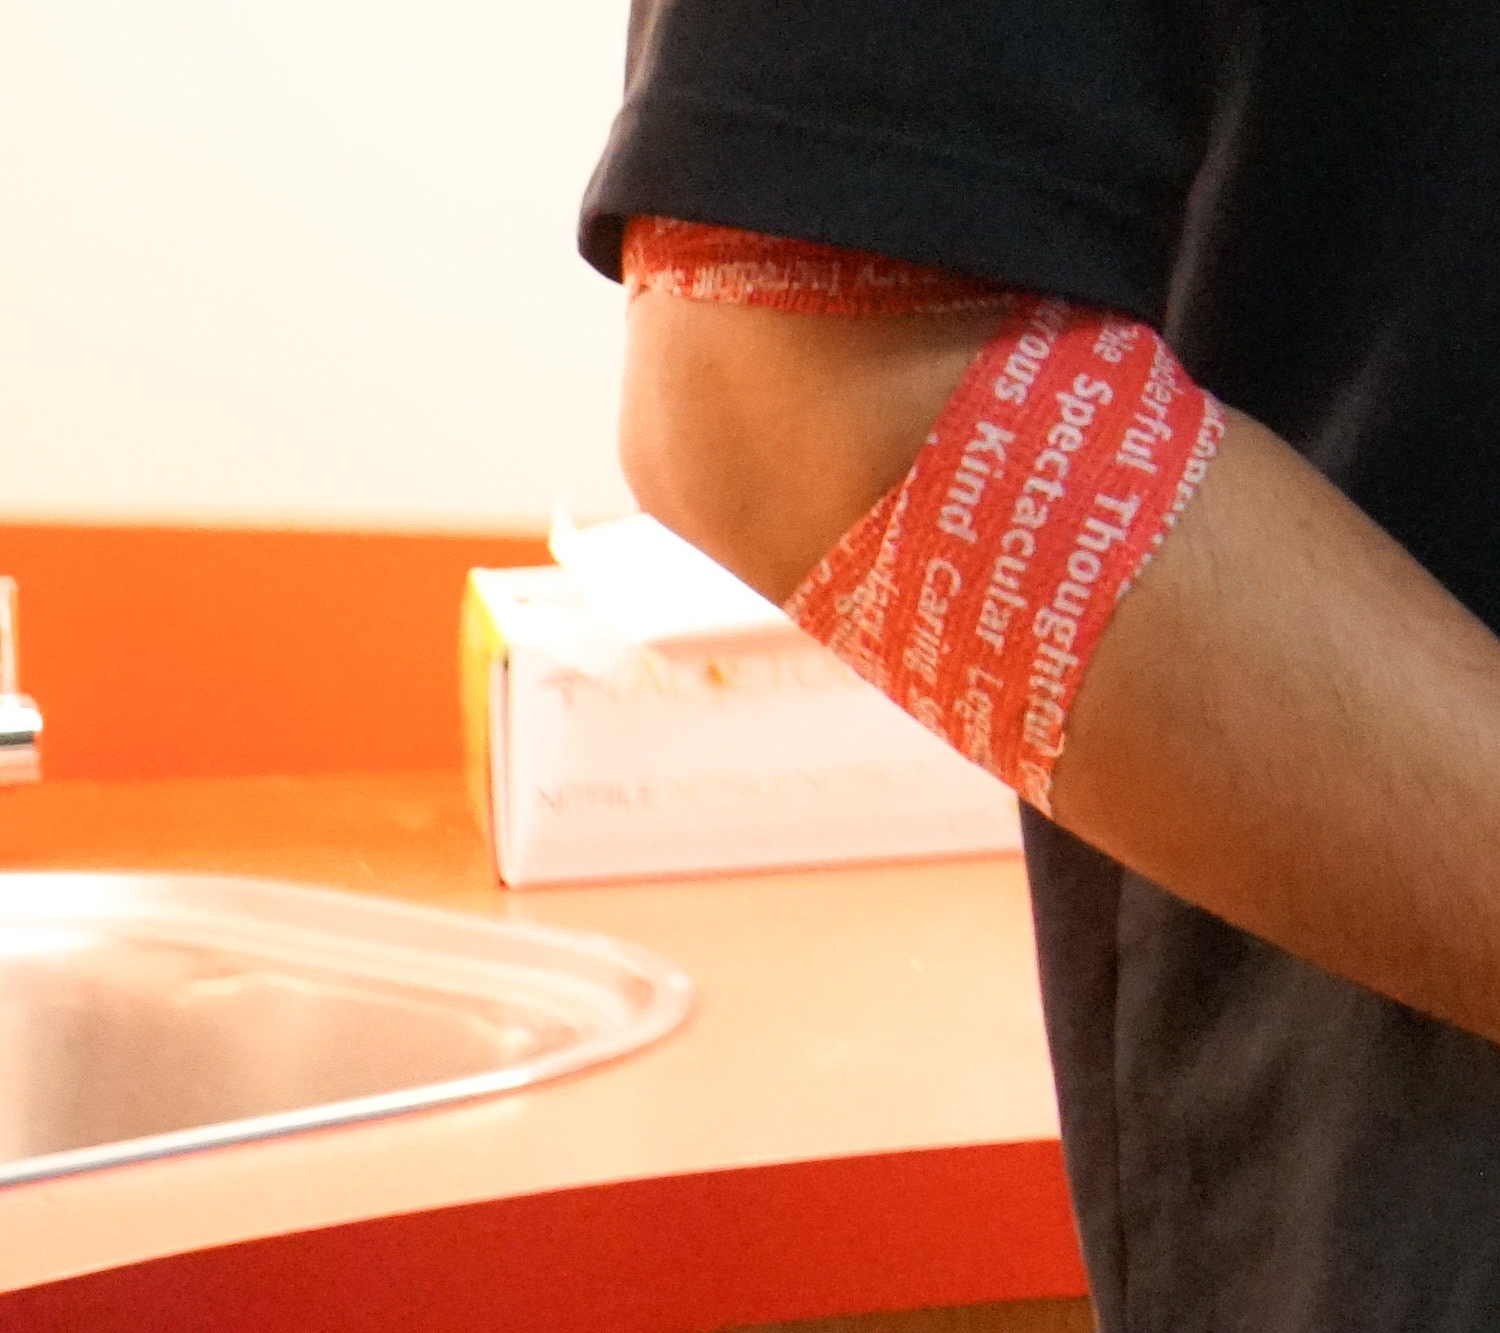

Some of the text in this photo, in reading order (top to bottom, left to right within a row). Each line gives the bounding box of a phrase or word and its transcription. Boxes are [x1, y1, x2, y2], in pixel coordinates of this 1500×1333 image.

[937, 419, 1018, 546] Kind
[975, 371, 1114, 656] Spectacular
[901, 556, 963, 685] Caring
[1022, 490, 1142, 759] Thoughtful
